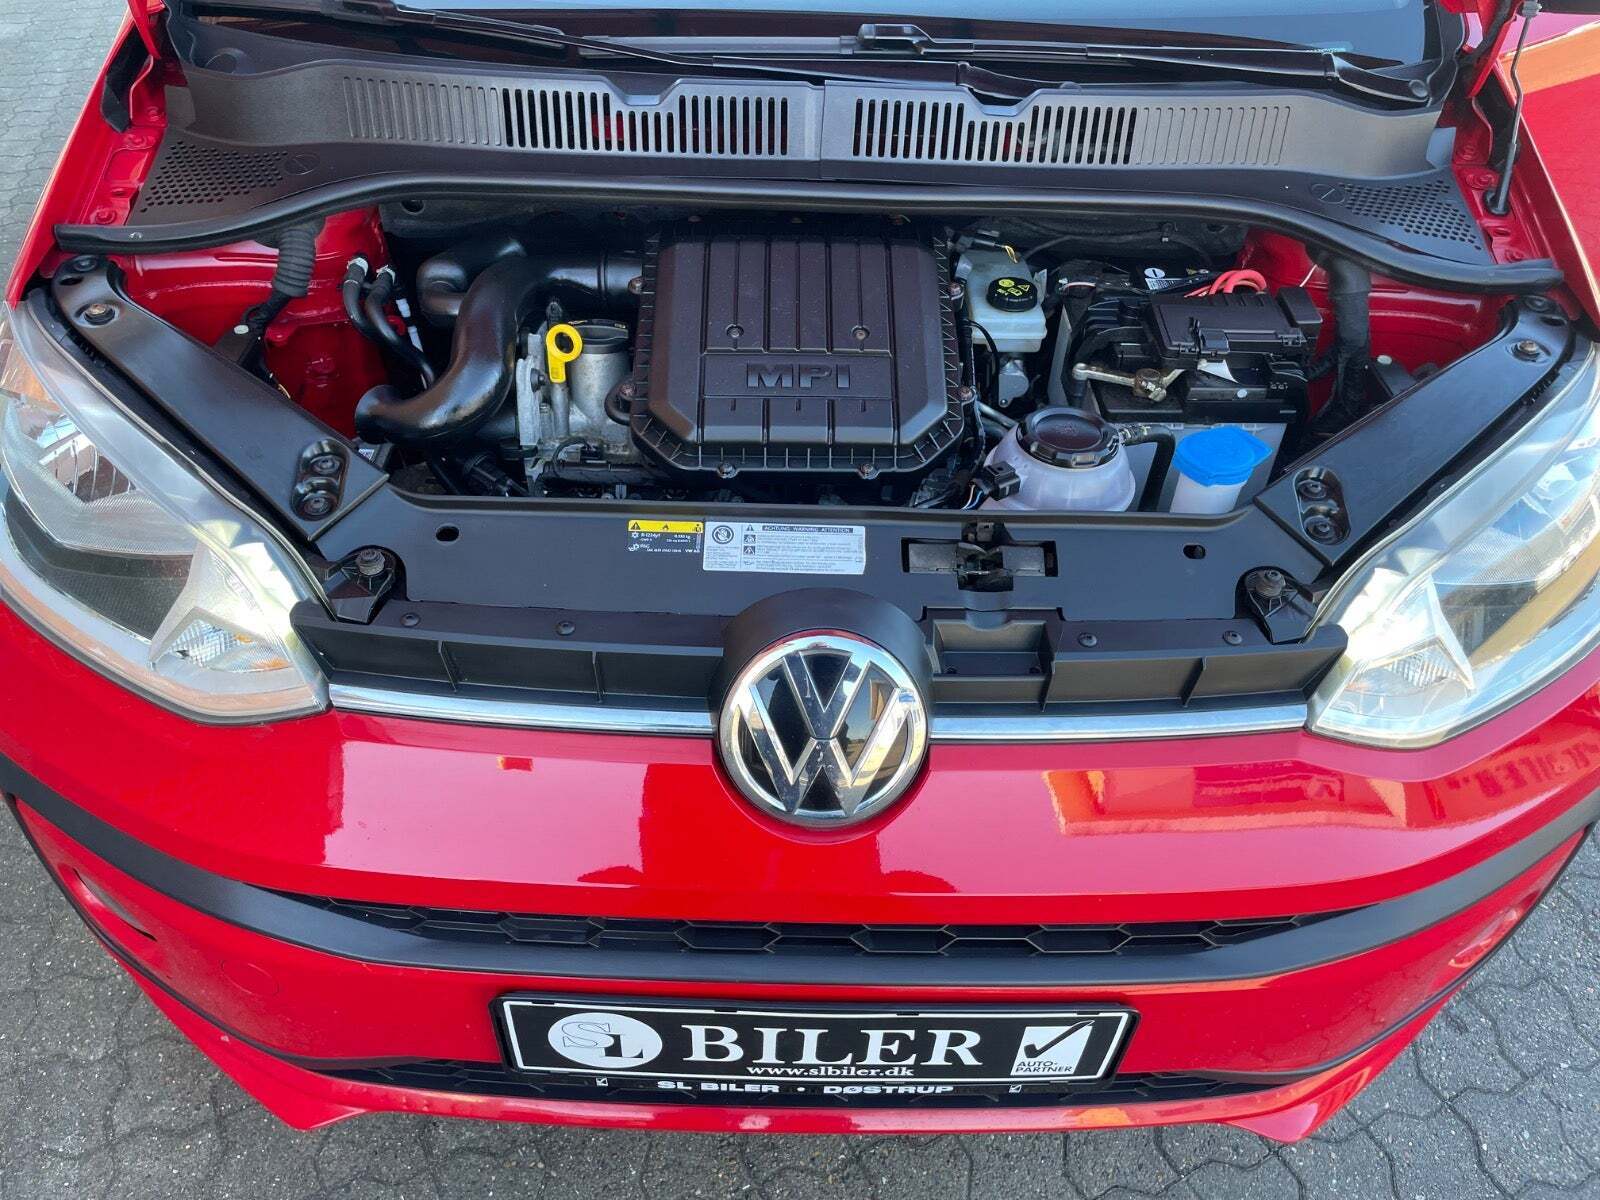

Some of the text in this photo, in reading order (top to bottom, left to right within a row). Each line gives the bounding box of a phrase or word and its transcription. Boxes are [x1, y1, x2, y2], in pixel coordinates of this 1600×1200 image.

[746, 363, 850, 388] MPI
[724, 634, 925, 824] VW
[561, 1020, 983, 1065] SL BILER
[746, 1064, 914, 1077] www.slbiler.dk
[657, 1080, 954, 1094] SL BILER DØSTRUP
